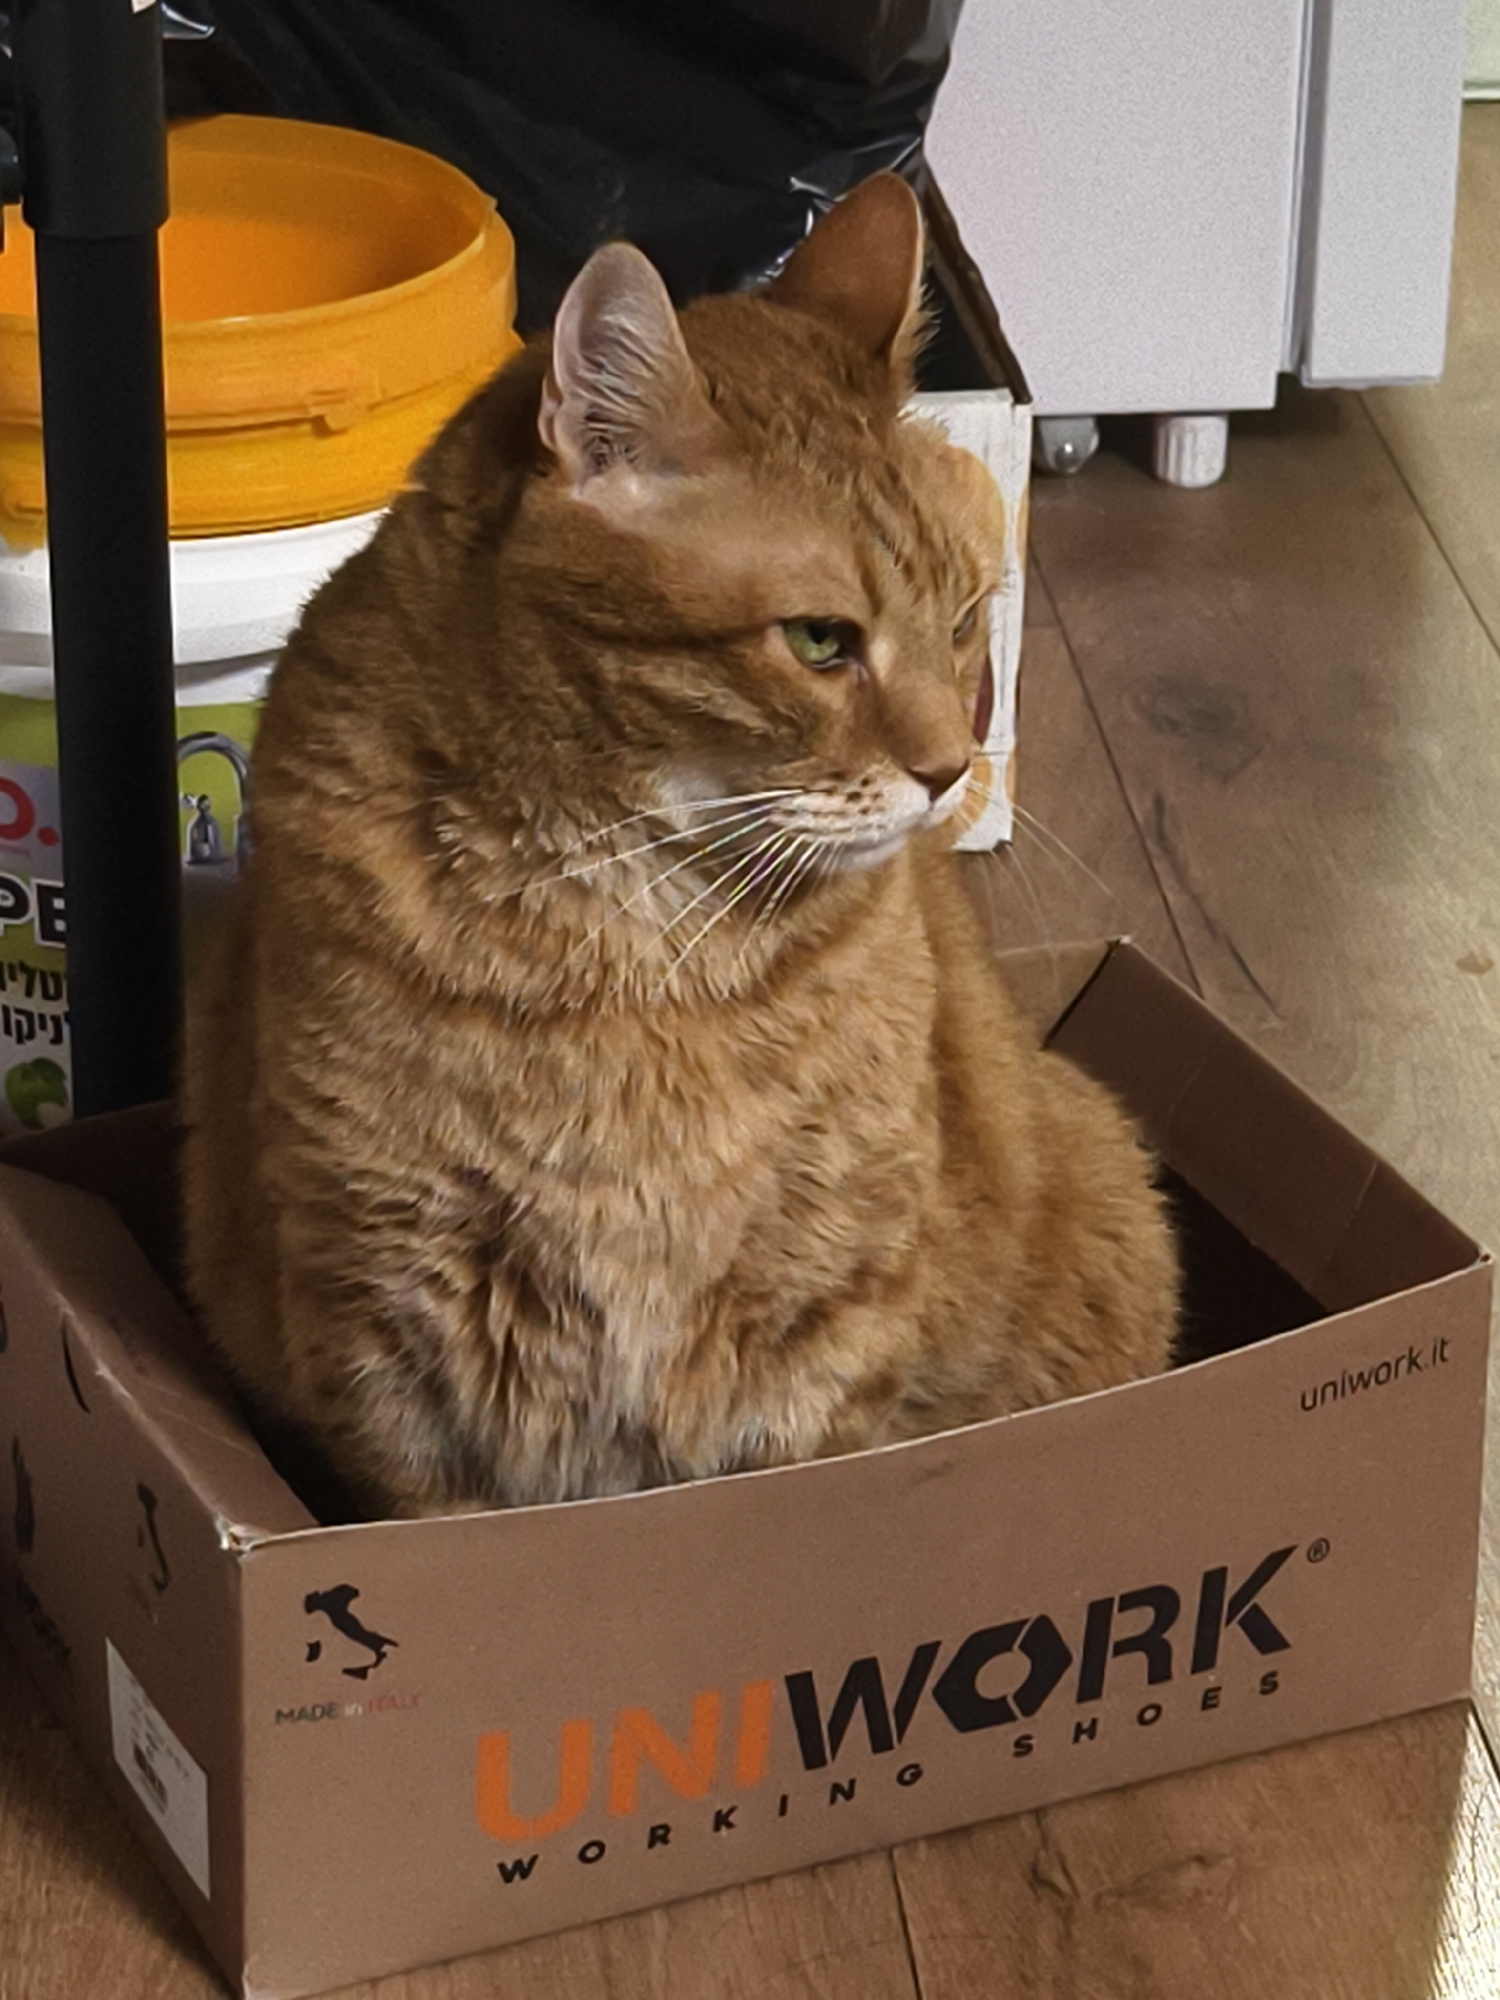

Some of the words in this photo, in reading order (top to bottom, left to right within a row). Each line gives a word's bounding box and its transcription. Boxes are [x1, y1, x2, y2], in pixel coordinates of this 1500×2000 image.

[1301, 1337, 1449, 1411] uniwork.it
[275, 1702, 338, 1725] MADE
[497, 1763, 923, 1884] WORKING
[1012, 1671, 1279, 1758] SHOES
